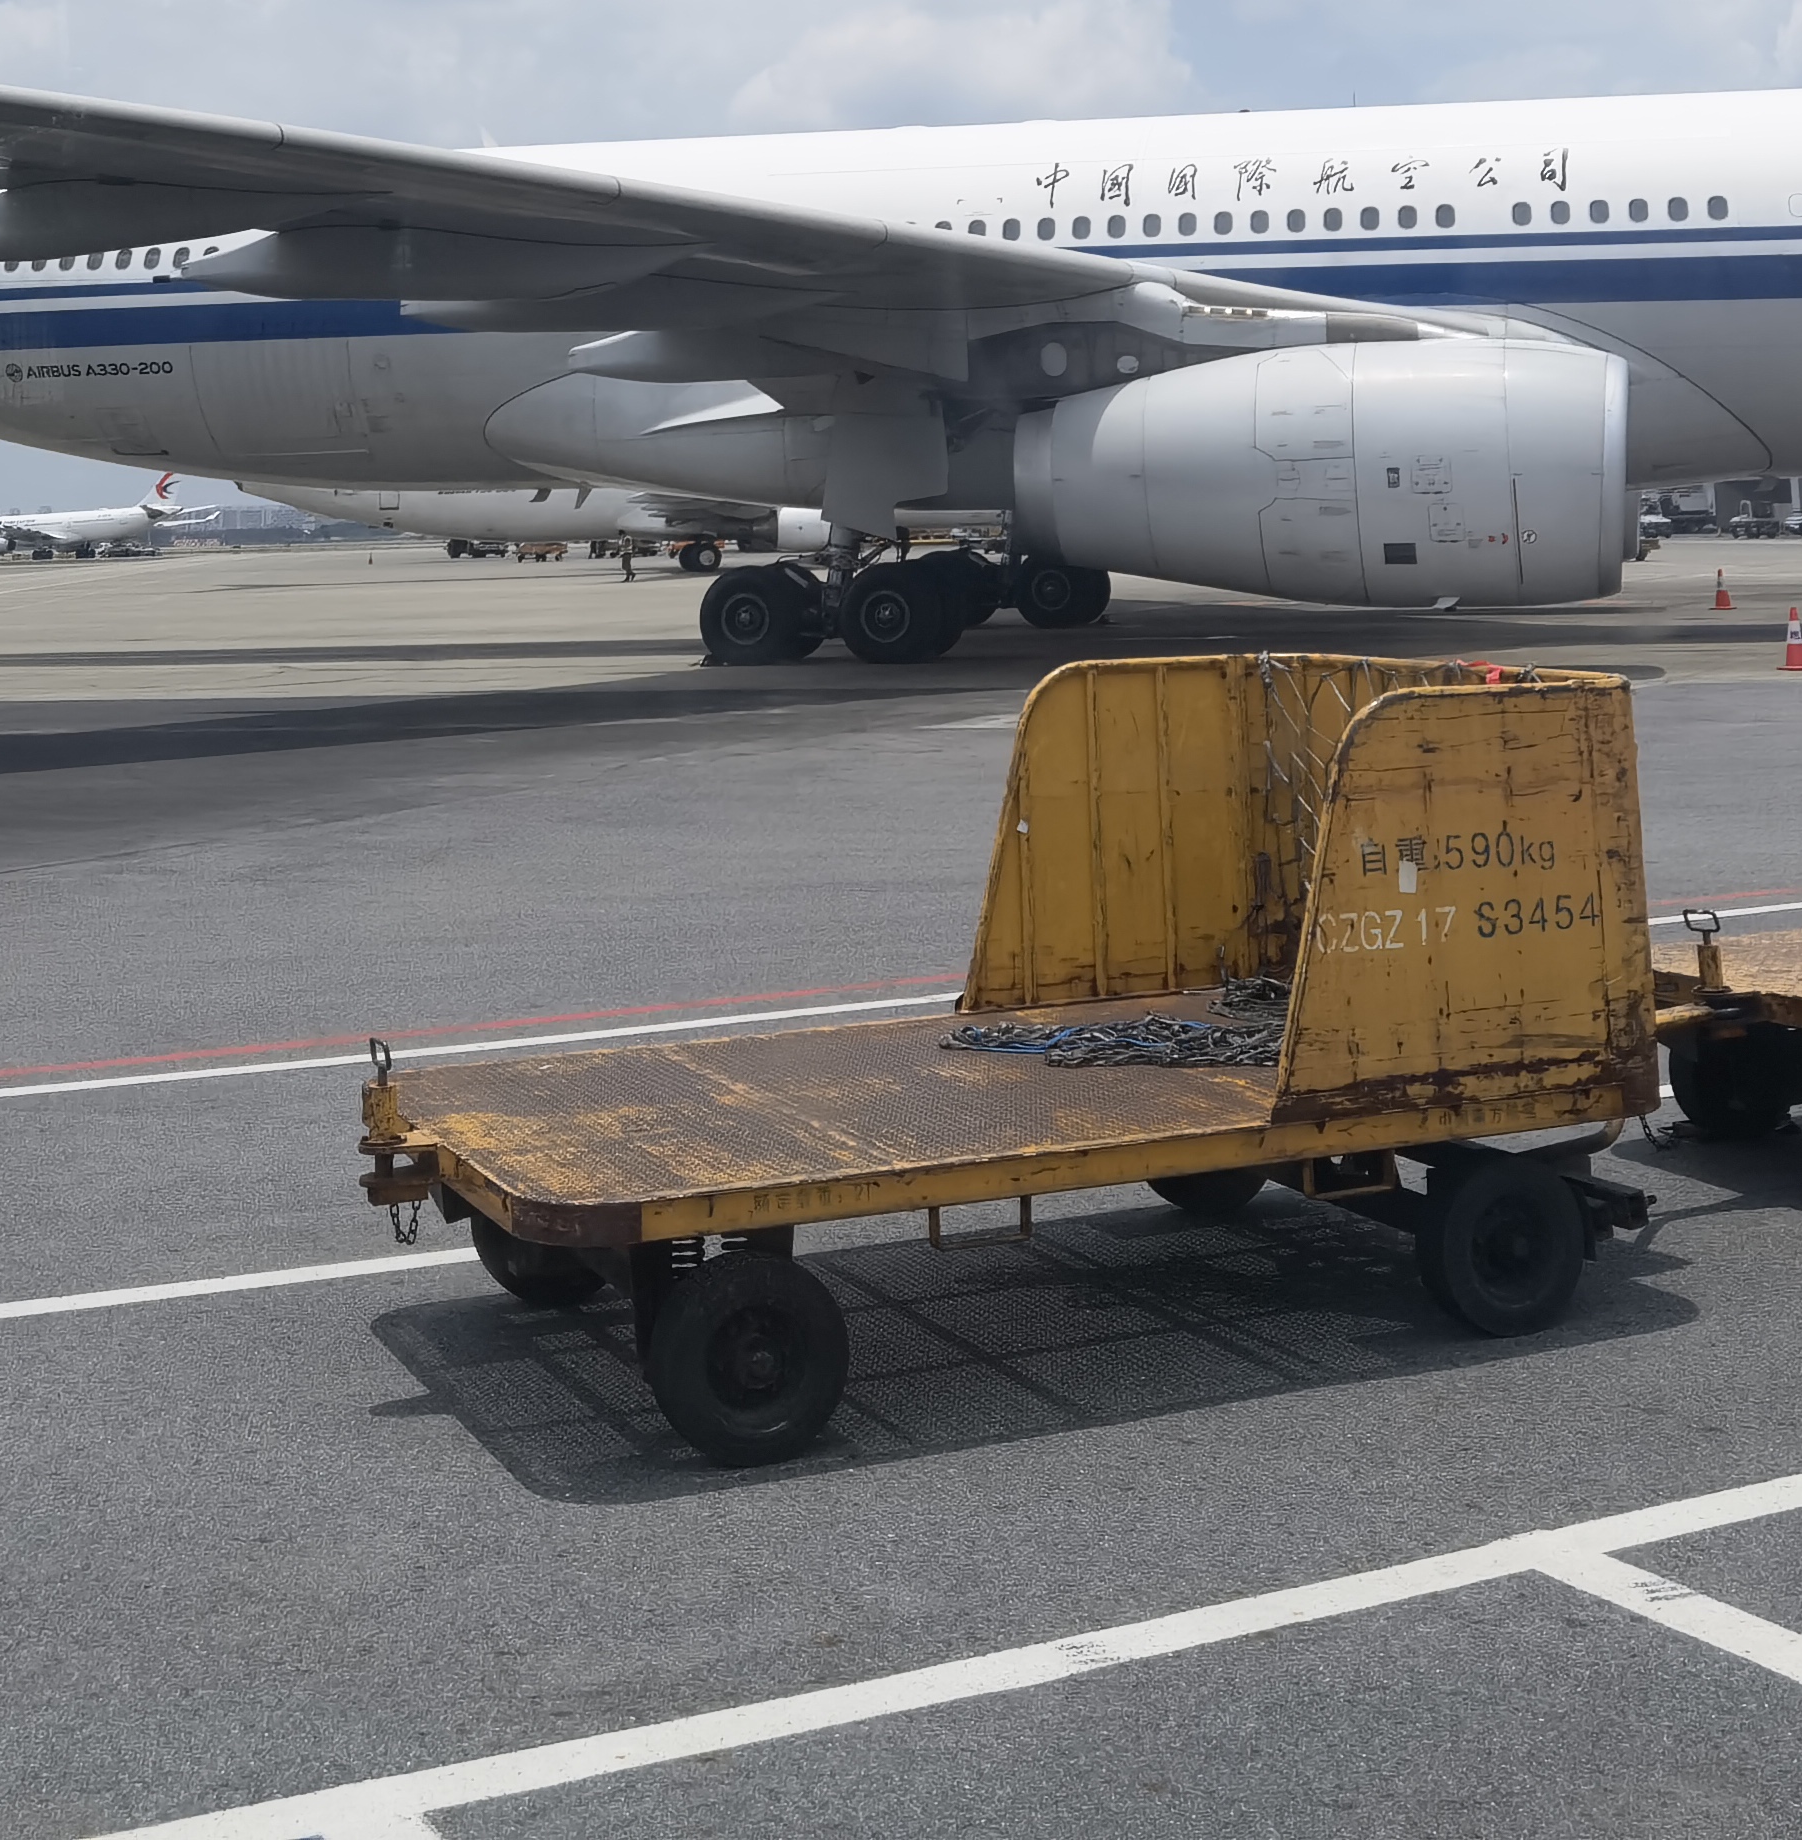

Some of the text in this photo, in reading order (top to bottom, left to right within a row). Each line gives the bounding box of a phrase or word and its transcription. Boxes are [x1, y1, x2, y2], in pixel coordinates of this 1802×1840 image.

[26, 360, 174, 379] AIRBUS A330-200
[1415, 905, 1457, 946] 17
[1474, 891, 1602, 939] S3454
